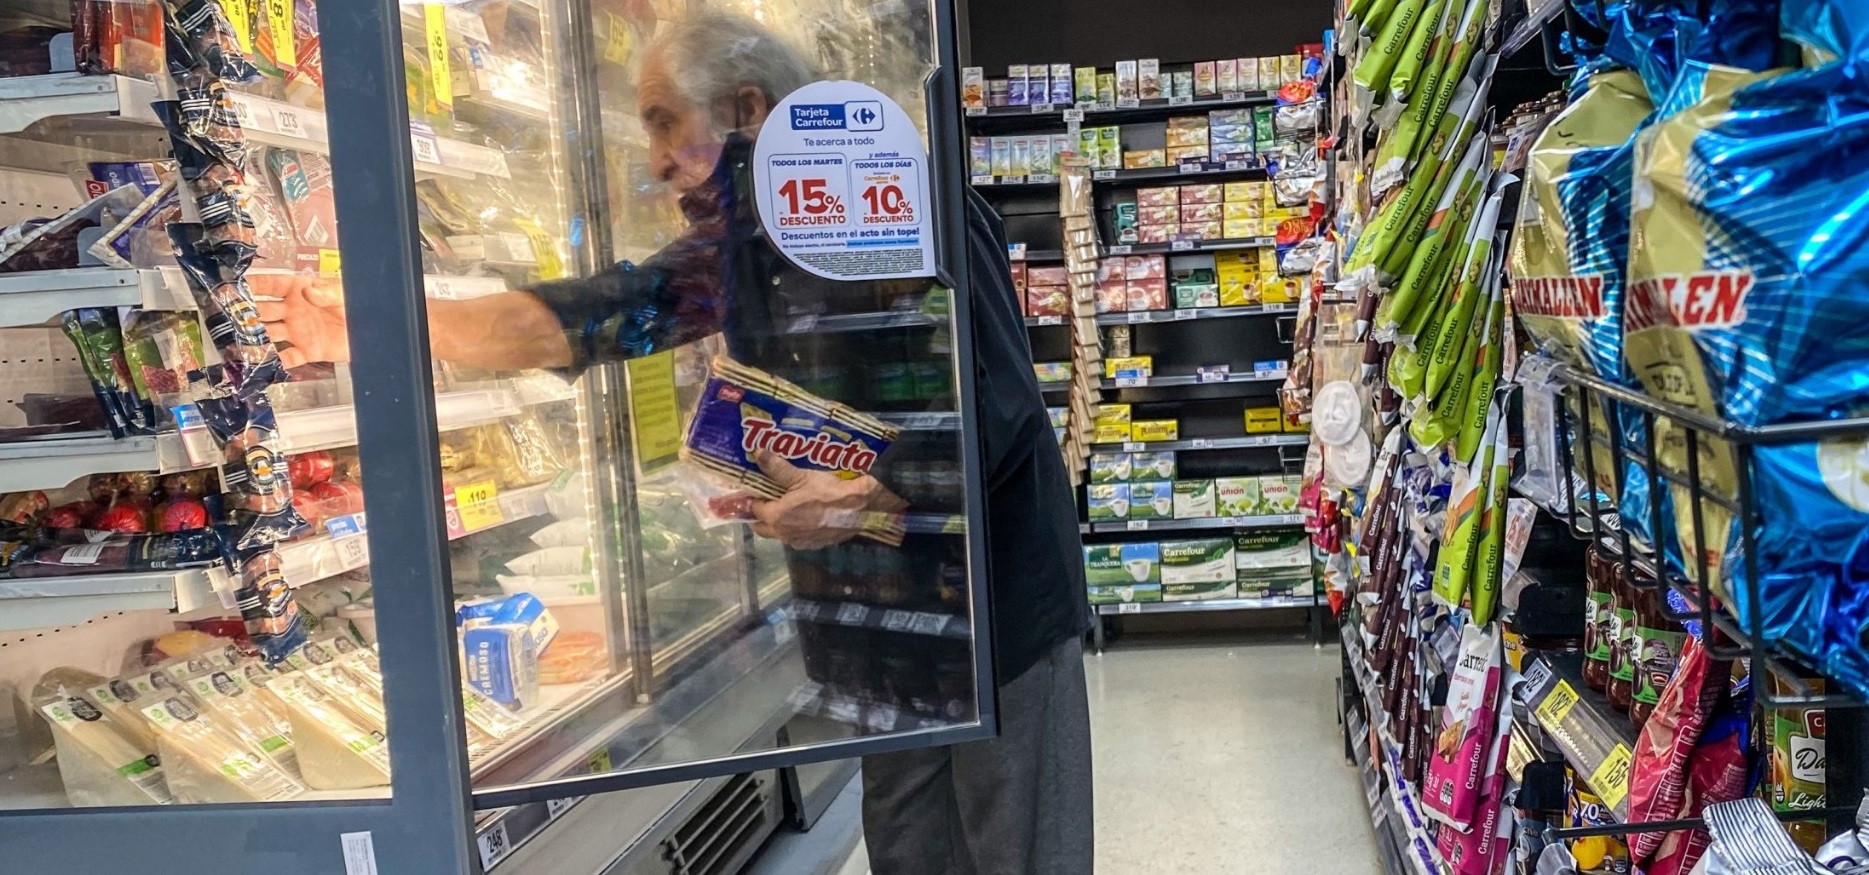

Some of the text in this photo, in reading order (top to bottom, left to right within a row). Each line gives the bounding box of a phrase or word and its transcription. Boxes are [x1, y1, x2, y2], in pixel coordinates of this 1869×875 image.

[1383, 7, 1414, 55] Carrefour
[1415, 12, 1440, 61] Carrefour
[794, 108, 829, 118] Tarjeta
[1414, 74, 1437, 123] Carrefour
[1428, 79, 1454, 128] Carrefour
[795, 118, 843, 128] Carrefour
[804, 138, 816, 146] Te
[854, 137, 875, 146] todo
[813, 158, 843, 166] MARTES
[895, 160, 912, 168] DÍAS
[780, 215, 846, 226] DESCUENTO
[863, 214, 914, 224] DESCUENTO
[1384, 185, 1414, 231] Carrefour
[1406, 196, 1435, 243] Carrefour
[781, 227, 920, 241] Descuentos en el acto sin tope!
[1411, 244, 1438, 290] Carrefour
[1417, 320, 1440, 367] Carrefour
[1435, 318, 1458, 365] Carrefour
[1442, 371, 1465, 418] Carrefour
[1473, 381, 1490, 429] Carrefour
[742, 417, 876, 473] Traviata
[1239, 536, 1279, 544] Carrefour
[1368, 504, 1381, 536] Carrefour
[1164, 547, 1205, 556] Carrefour
[1376, 538, 1387, 570] Carrefour
[1462, 523, 1478, 571] Carrefour
[1484, 544, 1497, 591] Carrefour
[1378, 618, 1390, 650] Carrefour
[479, 641, 494, 695] CREMOSO
[1389, 658, 1398, 691] Carrefour
[1400, 687, 1408, 721] Carrefour
[1466, 742, 1482, 790] Carrefour
[1478, 809, 1495, 855] Carrefour
